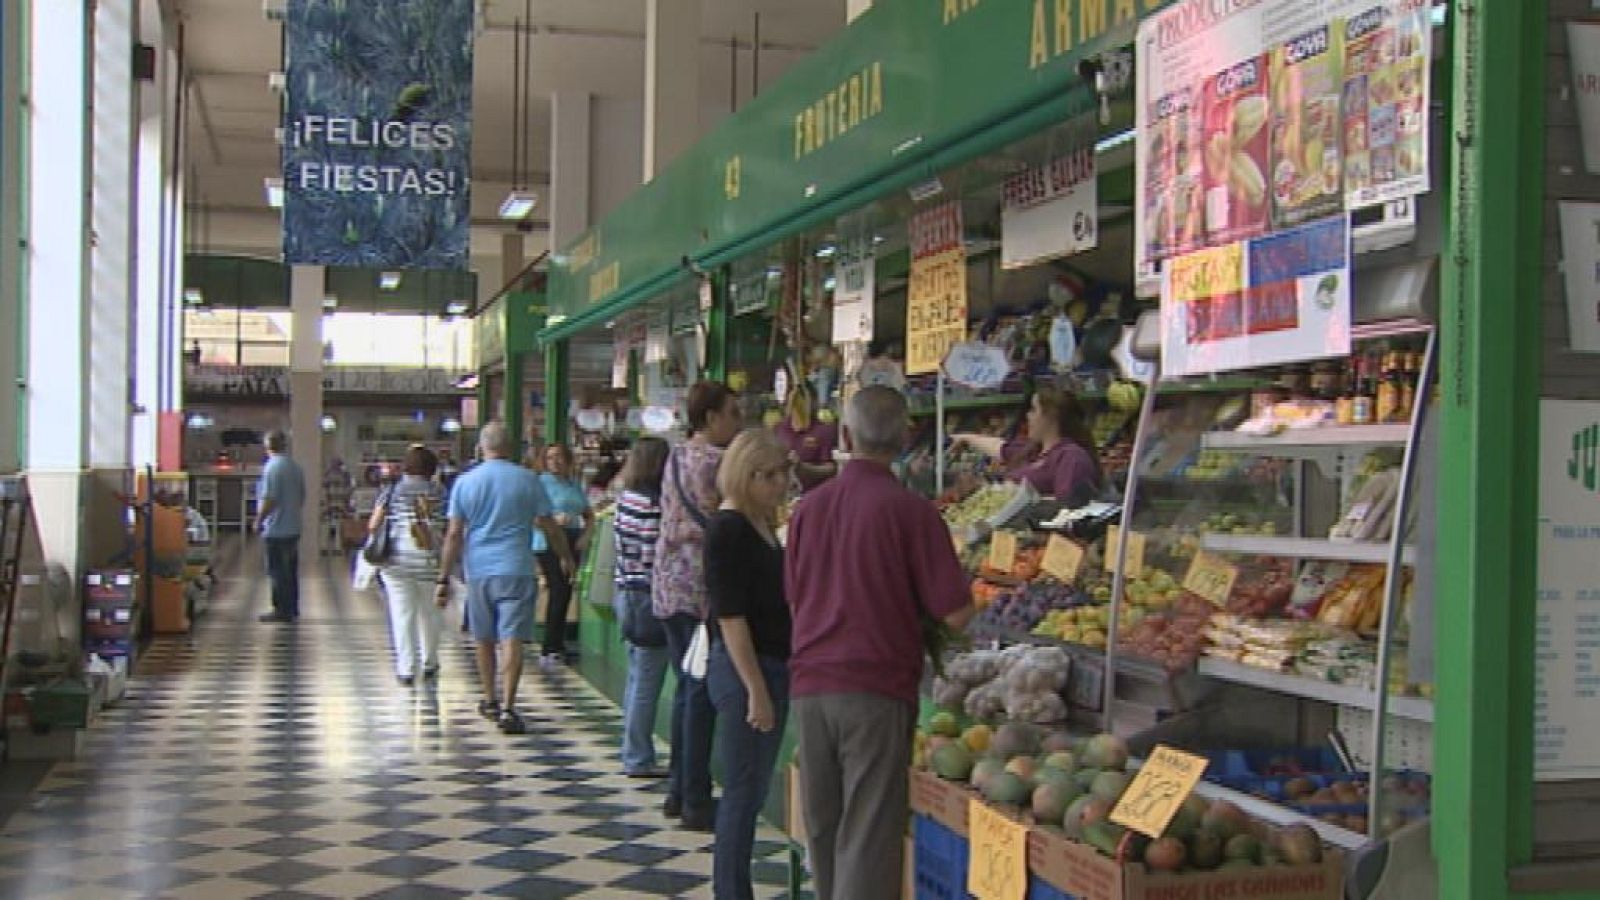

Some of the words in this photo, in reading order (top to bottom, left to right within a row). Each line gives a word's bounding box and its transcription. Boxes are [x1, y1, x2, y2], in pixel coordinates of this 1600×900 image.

[1285, 26, 1328, 63] GOYA
[1215, 60, 1258, 95] GOYA
[794, 62, 882, 162] FRUTERIA
[292, 114, 454, 152] ¡FELICES
[299, 163, 456, 197] FIESTAS!
